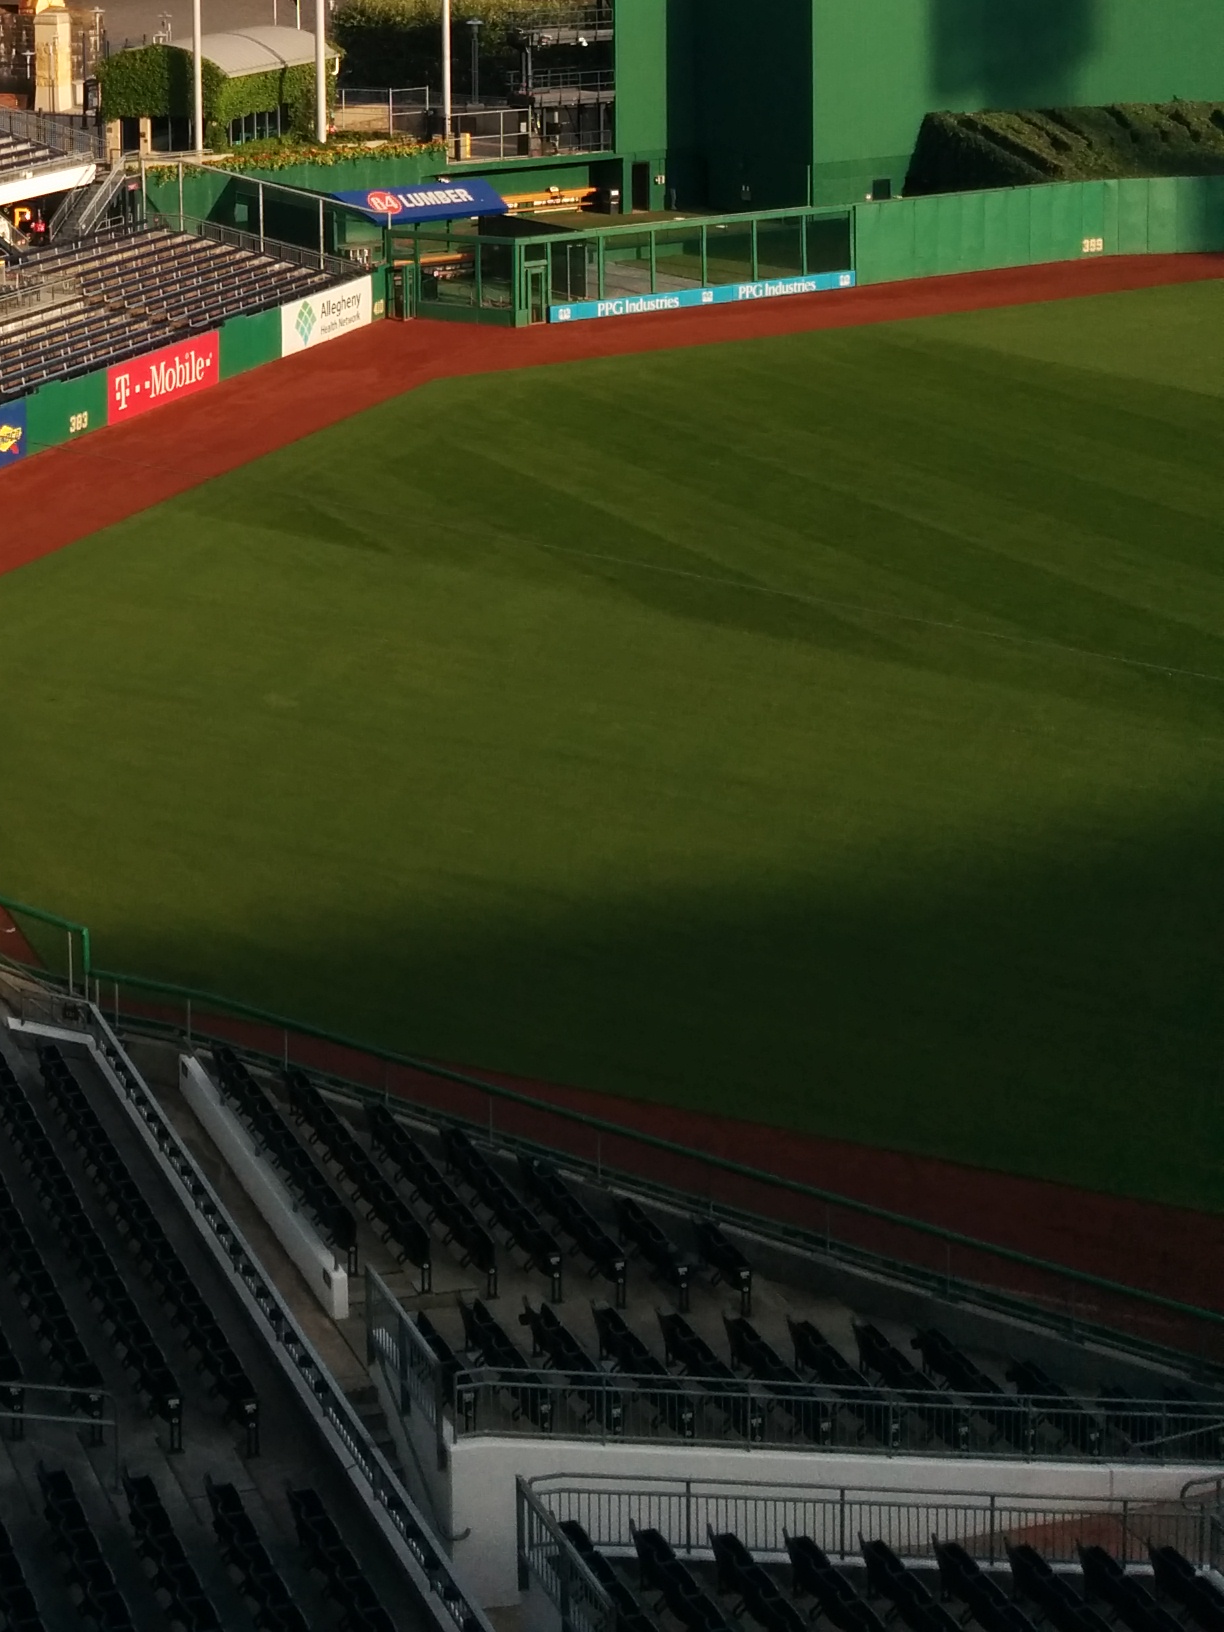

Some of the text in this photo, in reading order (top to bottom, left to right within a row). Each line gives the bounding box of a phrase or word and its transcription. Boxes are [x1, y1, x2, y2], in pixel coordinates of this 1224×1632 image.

[375, 188, 474, 211] 84 LUMBER
[321, 294, 362, 318] Allegheny
[598, 278, 816, 317] PPG Industries PPG Industries
[321, 311, 361, 335] Health Network
[69, 411, 88, 433] 383
